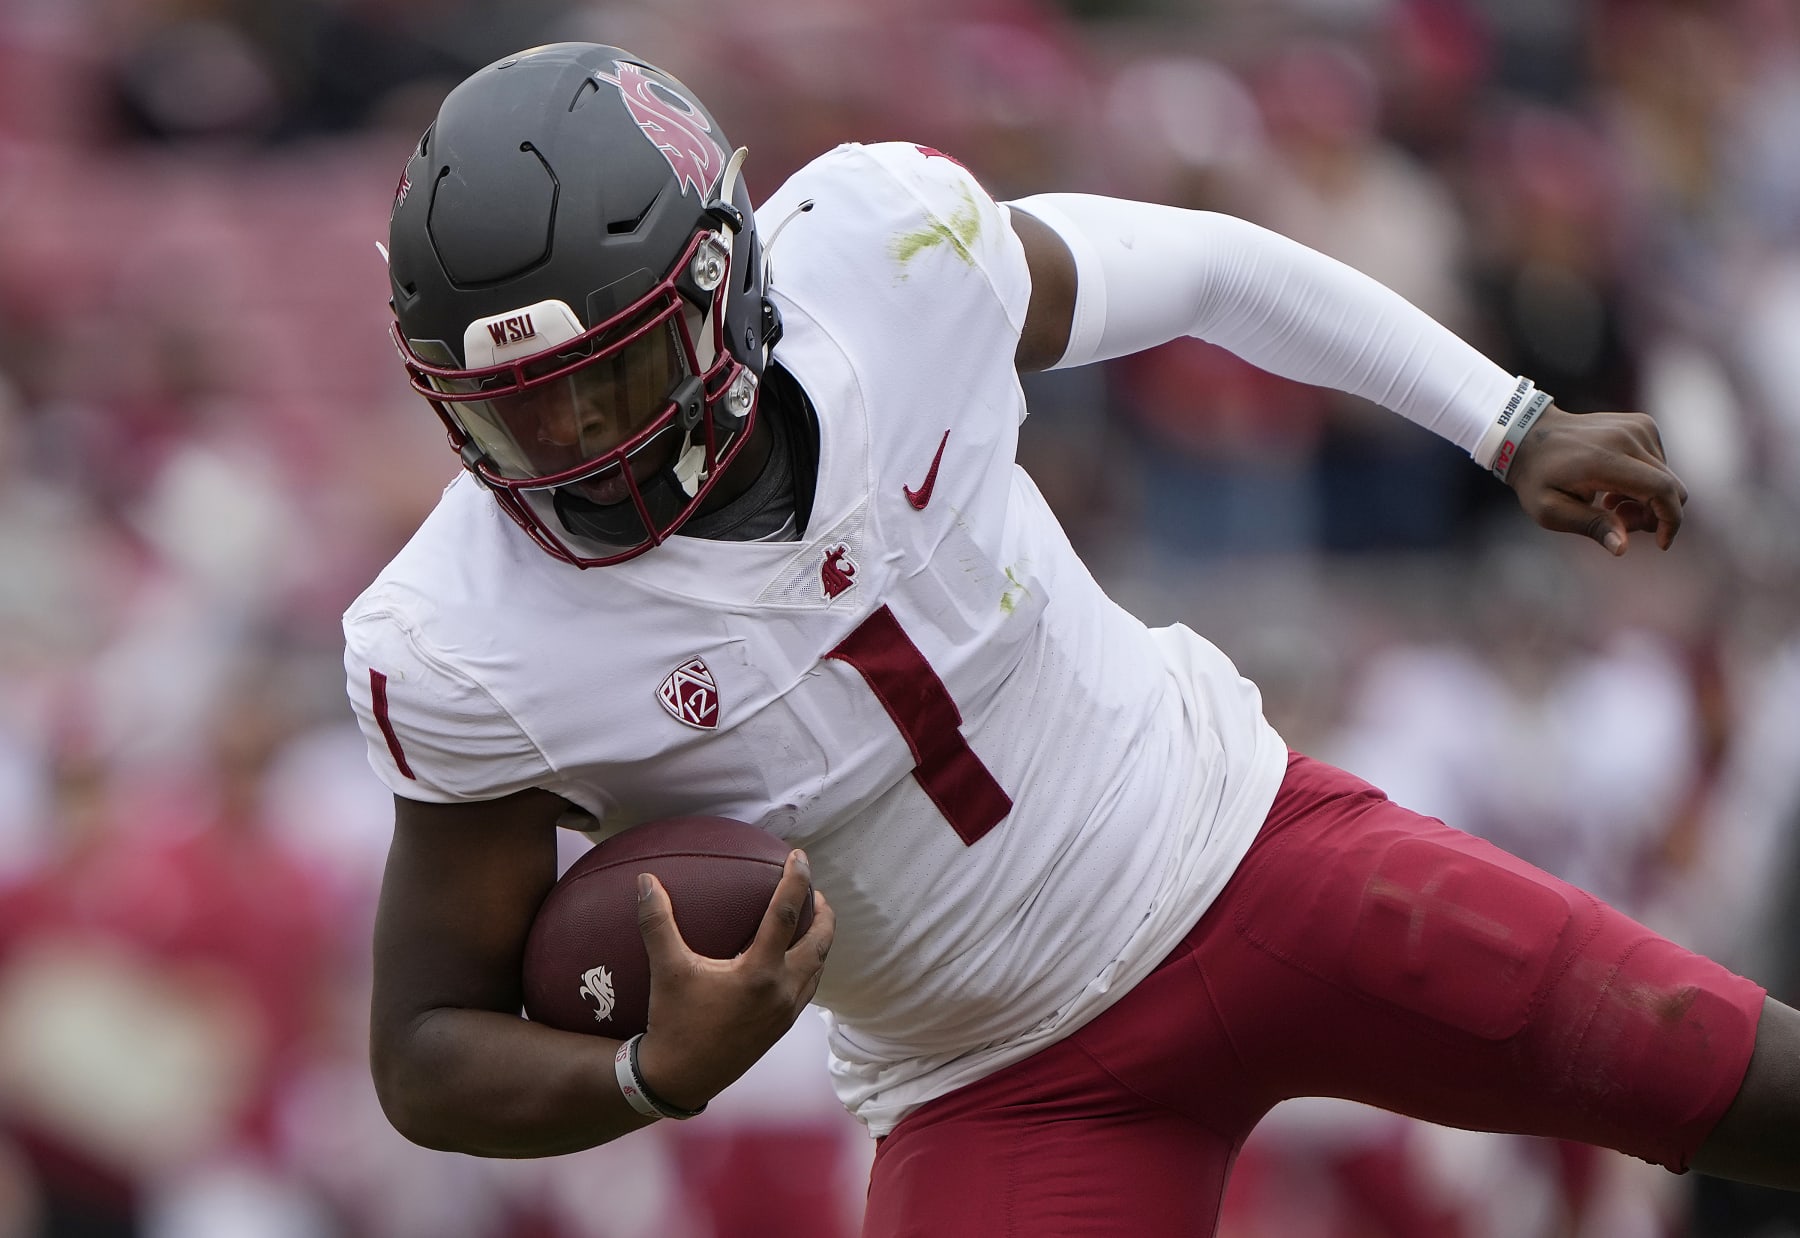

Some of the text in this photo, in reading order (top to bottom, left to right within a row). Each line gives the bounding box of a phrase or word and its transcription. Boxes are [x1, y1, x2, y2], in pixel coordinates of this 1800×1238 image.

[487, 313, 536, 347] WSU
[1497, 393, 1523, 427] FOREVER
[660, 660, 716, 719] PAC
[684, 688, 717, 724] 12
[821, 603, 1014, 847] 1
